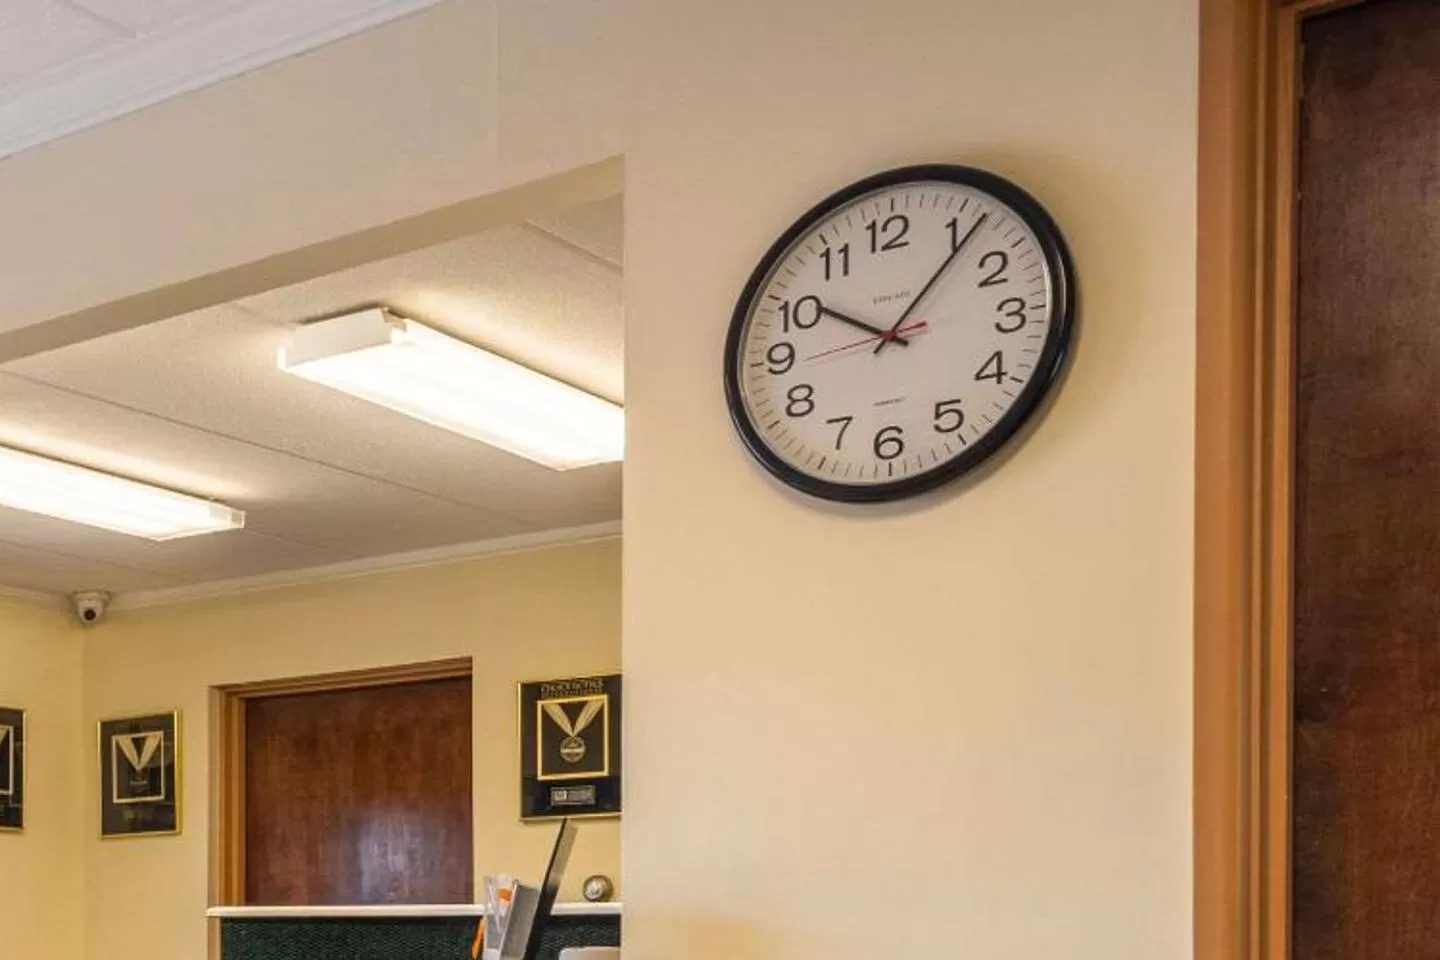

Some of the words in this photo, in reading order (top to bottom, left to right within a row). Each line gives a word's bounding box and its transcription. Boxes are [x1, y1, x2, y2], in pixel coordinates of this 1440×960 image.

[865, 214, 909, 253] 12
[945, 217, 959, 251] 1
[819, 243, 849, 280] 11
[977, 251, 1008, 288] 2
[778, 295, 823, 332] 10
[995, 298, 1026, 333] 3
[766, 342, 795, 375] 9
[974, 351, 1007, 384] 4
[785, 384, 814, 417] 8
[933, 399, 965, 432] 5
[826, 416, 853, 450] 7
[873, 426, 904, 460] 6
